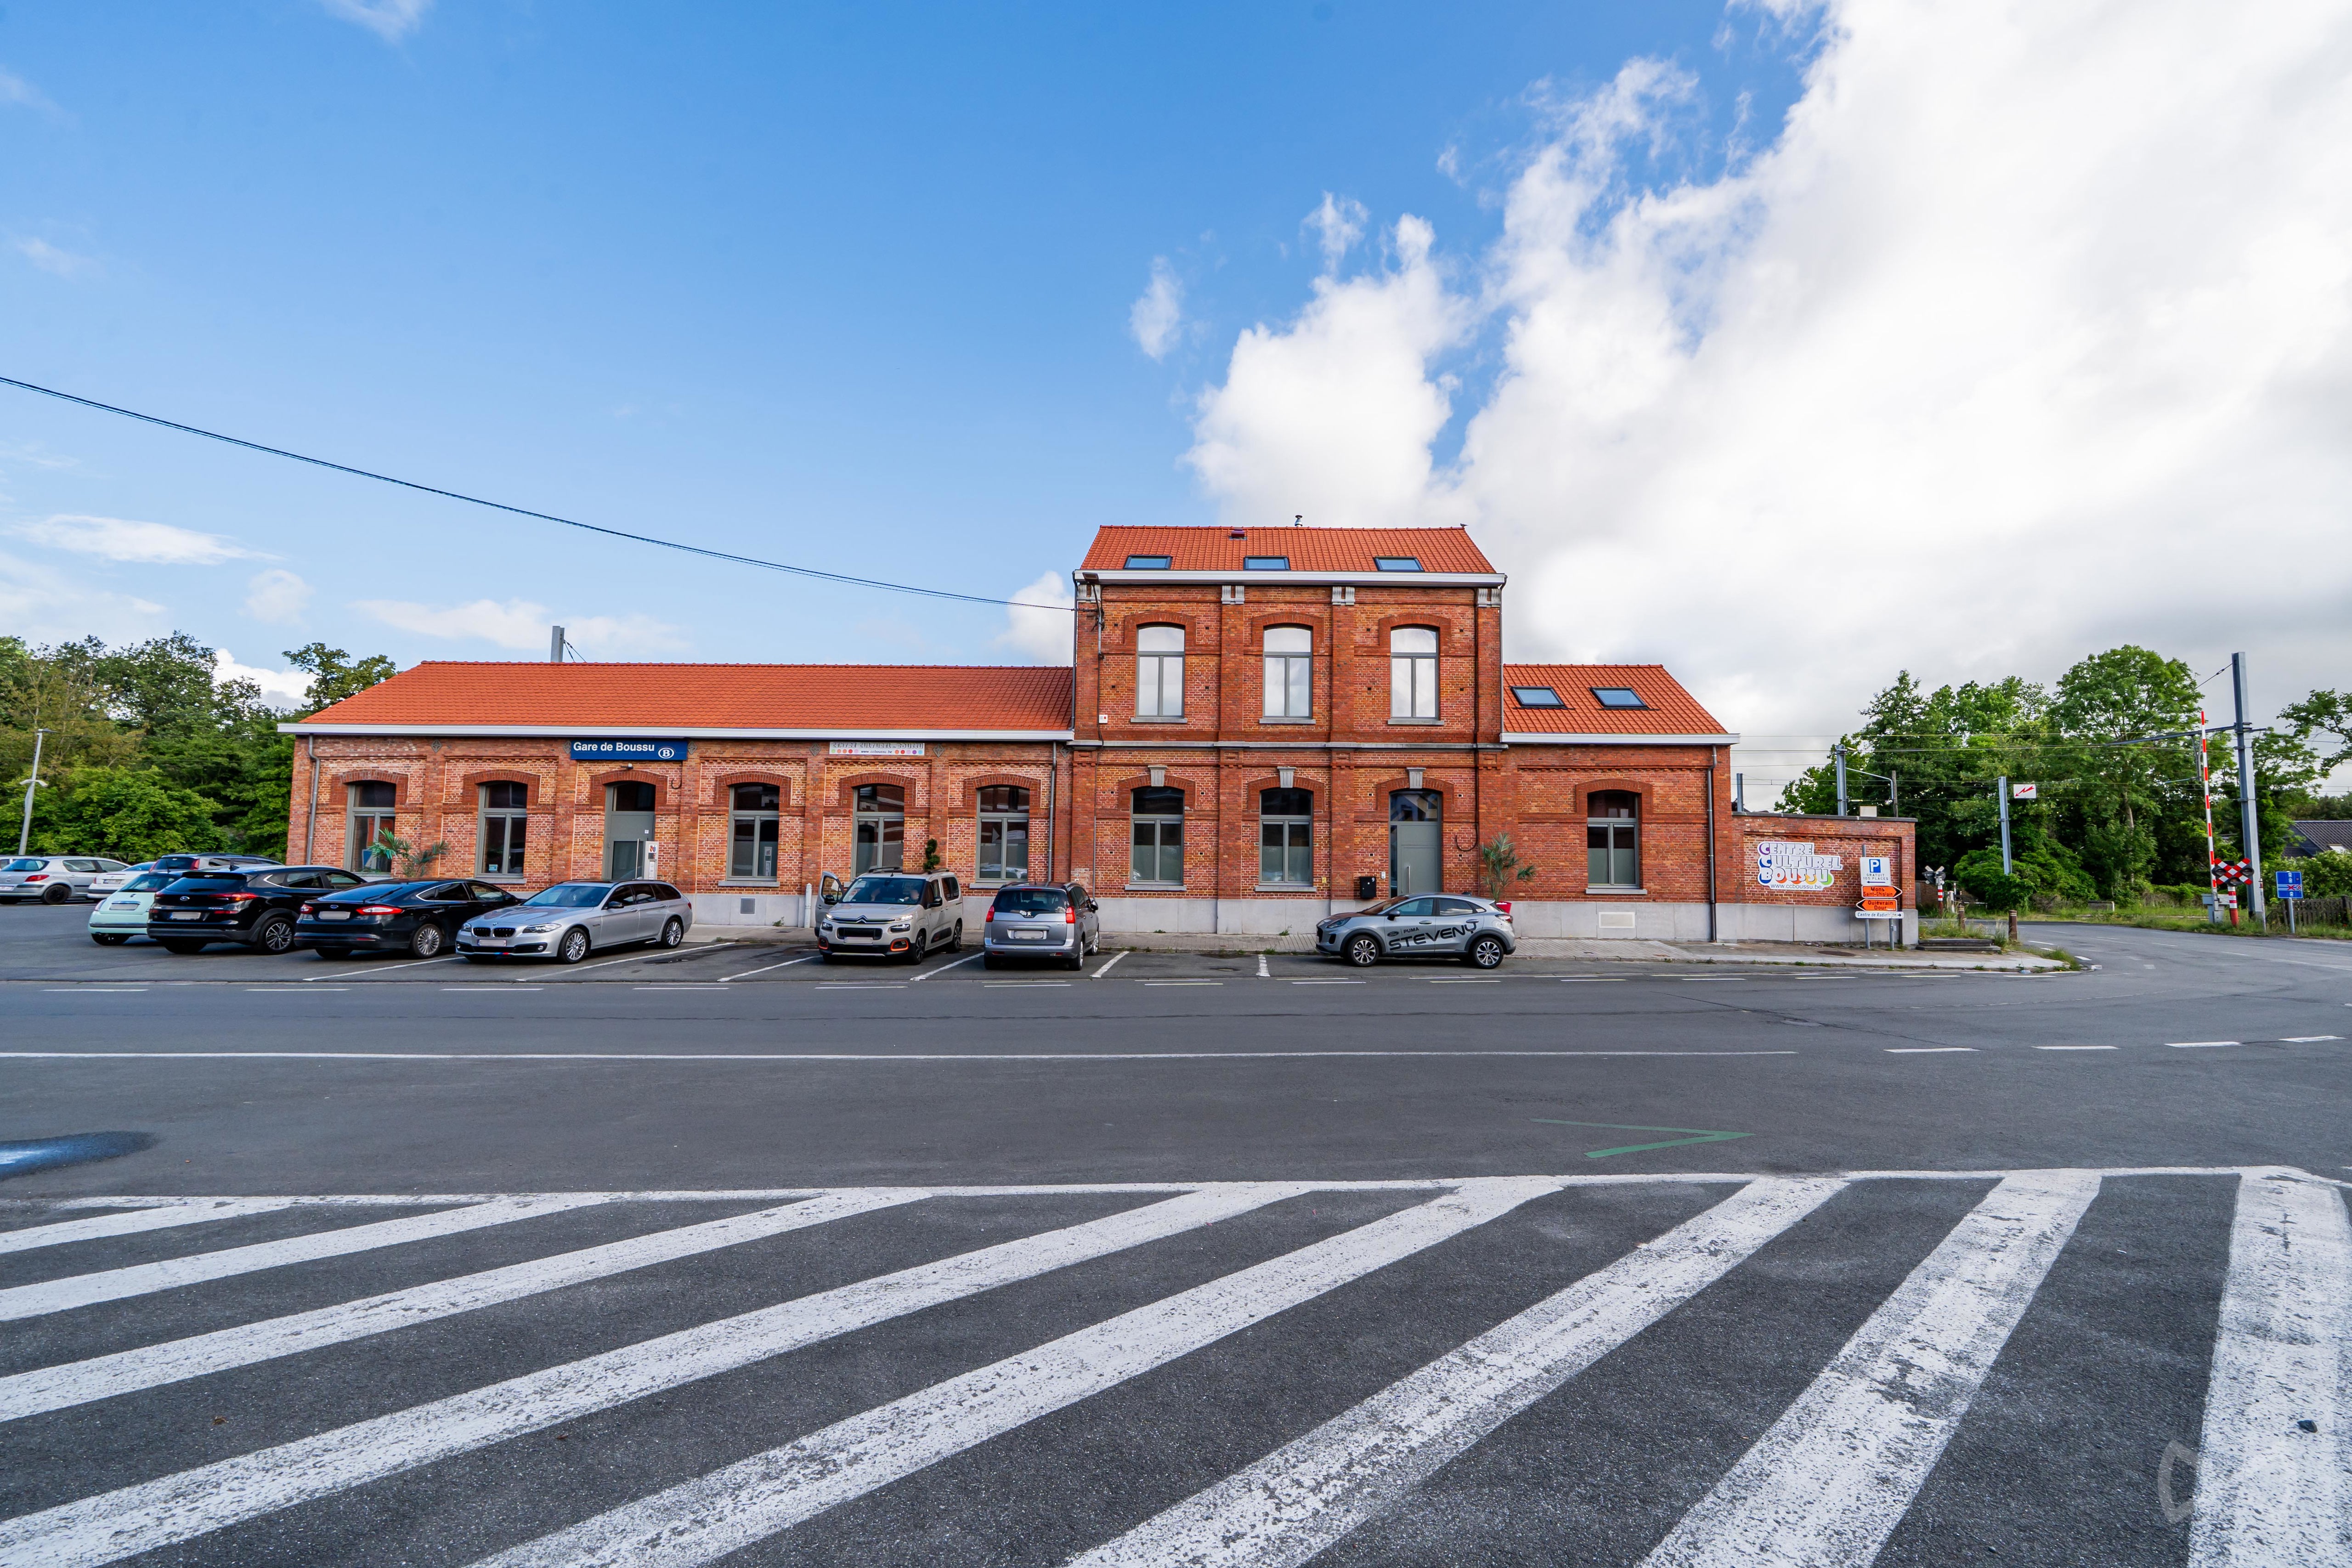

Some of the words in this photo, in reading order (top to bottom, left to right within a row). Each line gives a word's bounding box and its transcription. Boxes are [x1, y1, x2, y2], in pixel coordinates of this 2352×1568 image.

[573, 742, 598, 751] Gare
[600, 742, 613, 751] de
[616, 742, 655, 751] Boussu
[1759, 843, 1813, 855] CENTRE
[1759, 855, 1842, 869] CULTUREL
[1870, 860, 1879, 872] P
[1759, 867, 1829, 883] BOUSSU
[1389, 922, 1477, 951] STEVENY
